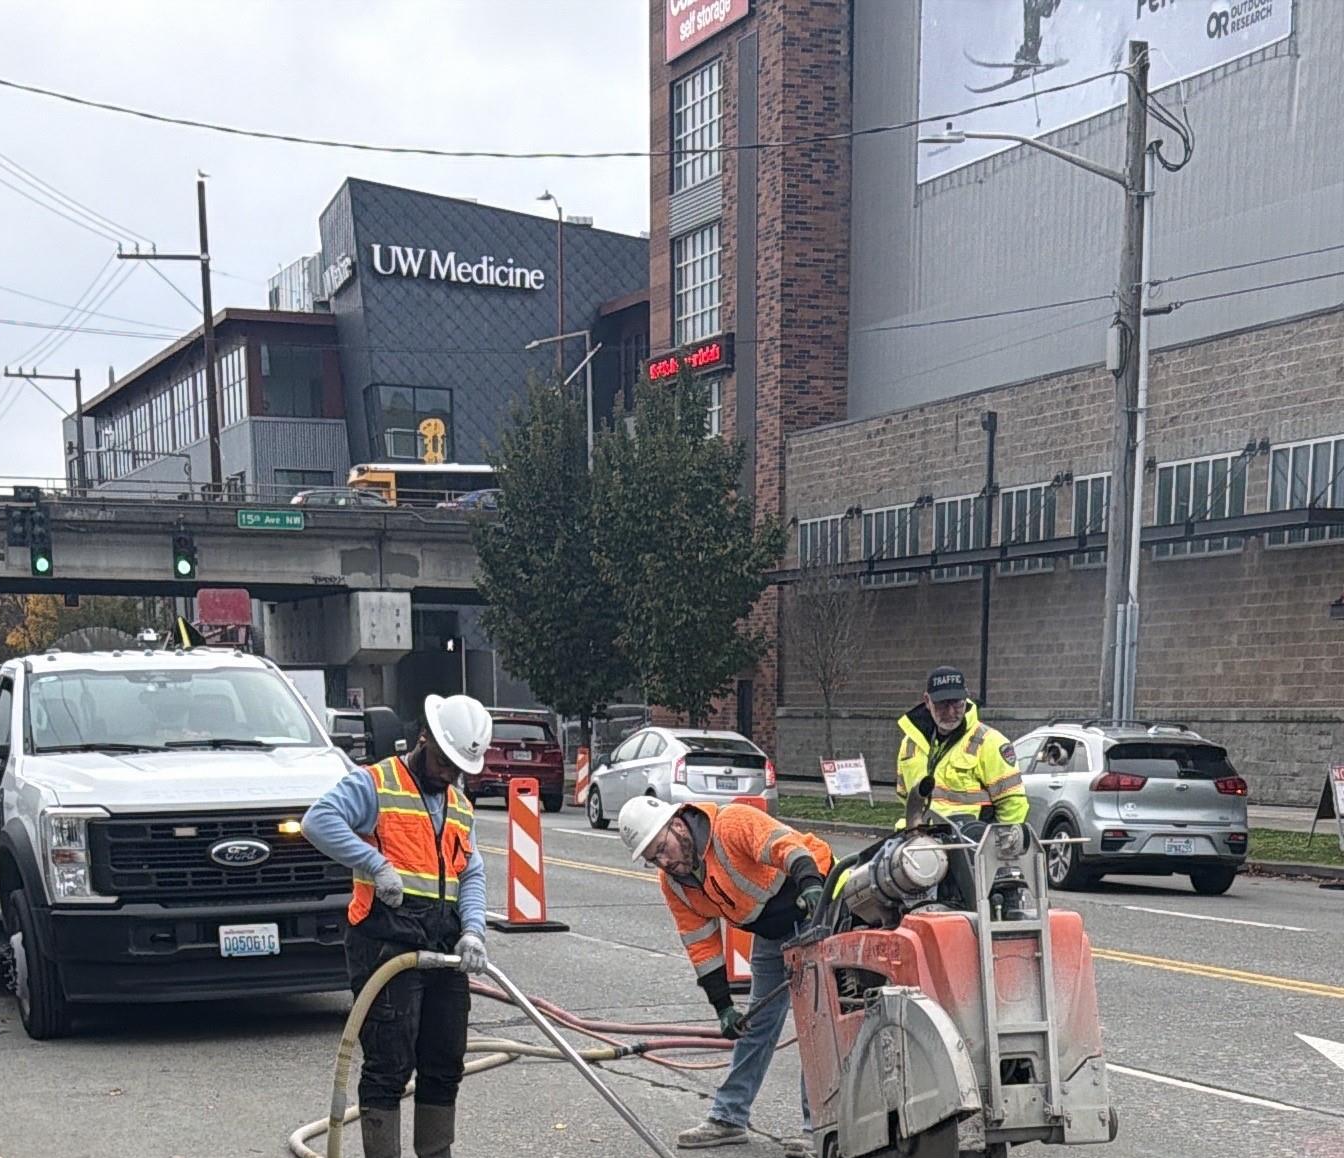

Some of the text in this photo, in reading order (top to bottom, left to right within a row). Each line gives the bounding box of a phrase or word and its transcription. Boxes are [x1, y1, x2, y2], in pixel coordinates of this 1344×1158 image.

[679, 11, 695, 41] self
[697, 0, 730, 30] storage
[1230, 0, 1272, 18] OUTDO
[1230, 4, 1272, 34] RESEARCH
[1206, 10, 1229, 38] OR
[371, 244, 426, 278] UW
[430, 250, 545, 290] Medicine
[225, 846, 257, 860] Ford
